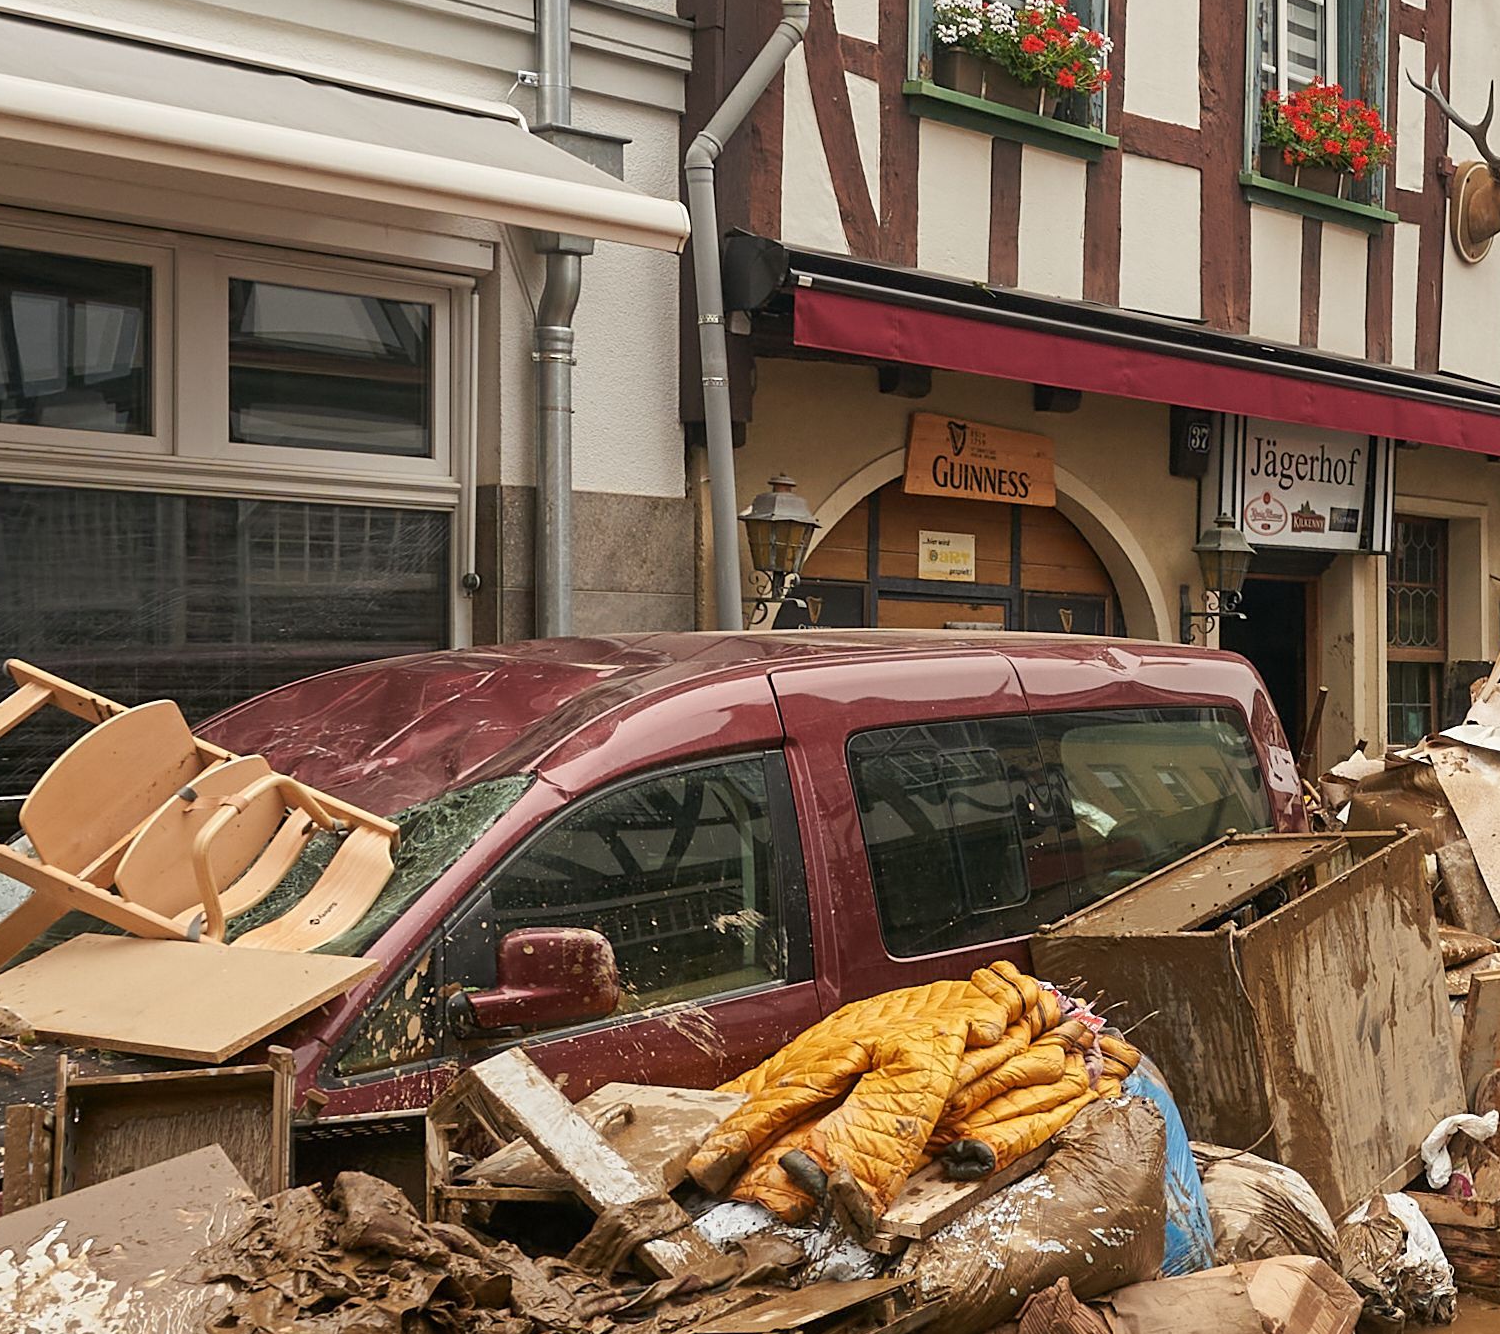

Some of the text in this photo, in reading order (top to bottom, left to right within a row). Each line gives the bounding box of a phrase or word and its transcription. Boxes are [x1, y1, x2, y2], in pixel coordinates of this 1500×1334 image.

[1190, 426, 1209, 450] 37
[932, 455, 1029, 499] GUINNESS
[1250, 436, 1361, 490] Jägerhof
[1293, 515, 1325, 528] KILKENNY
